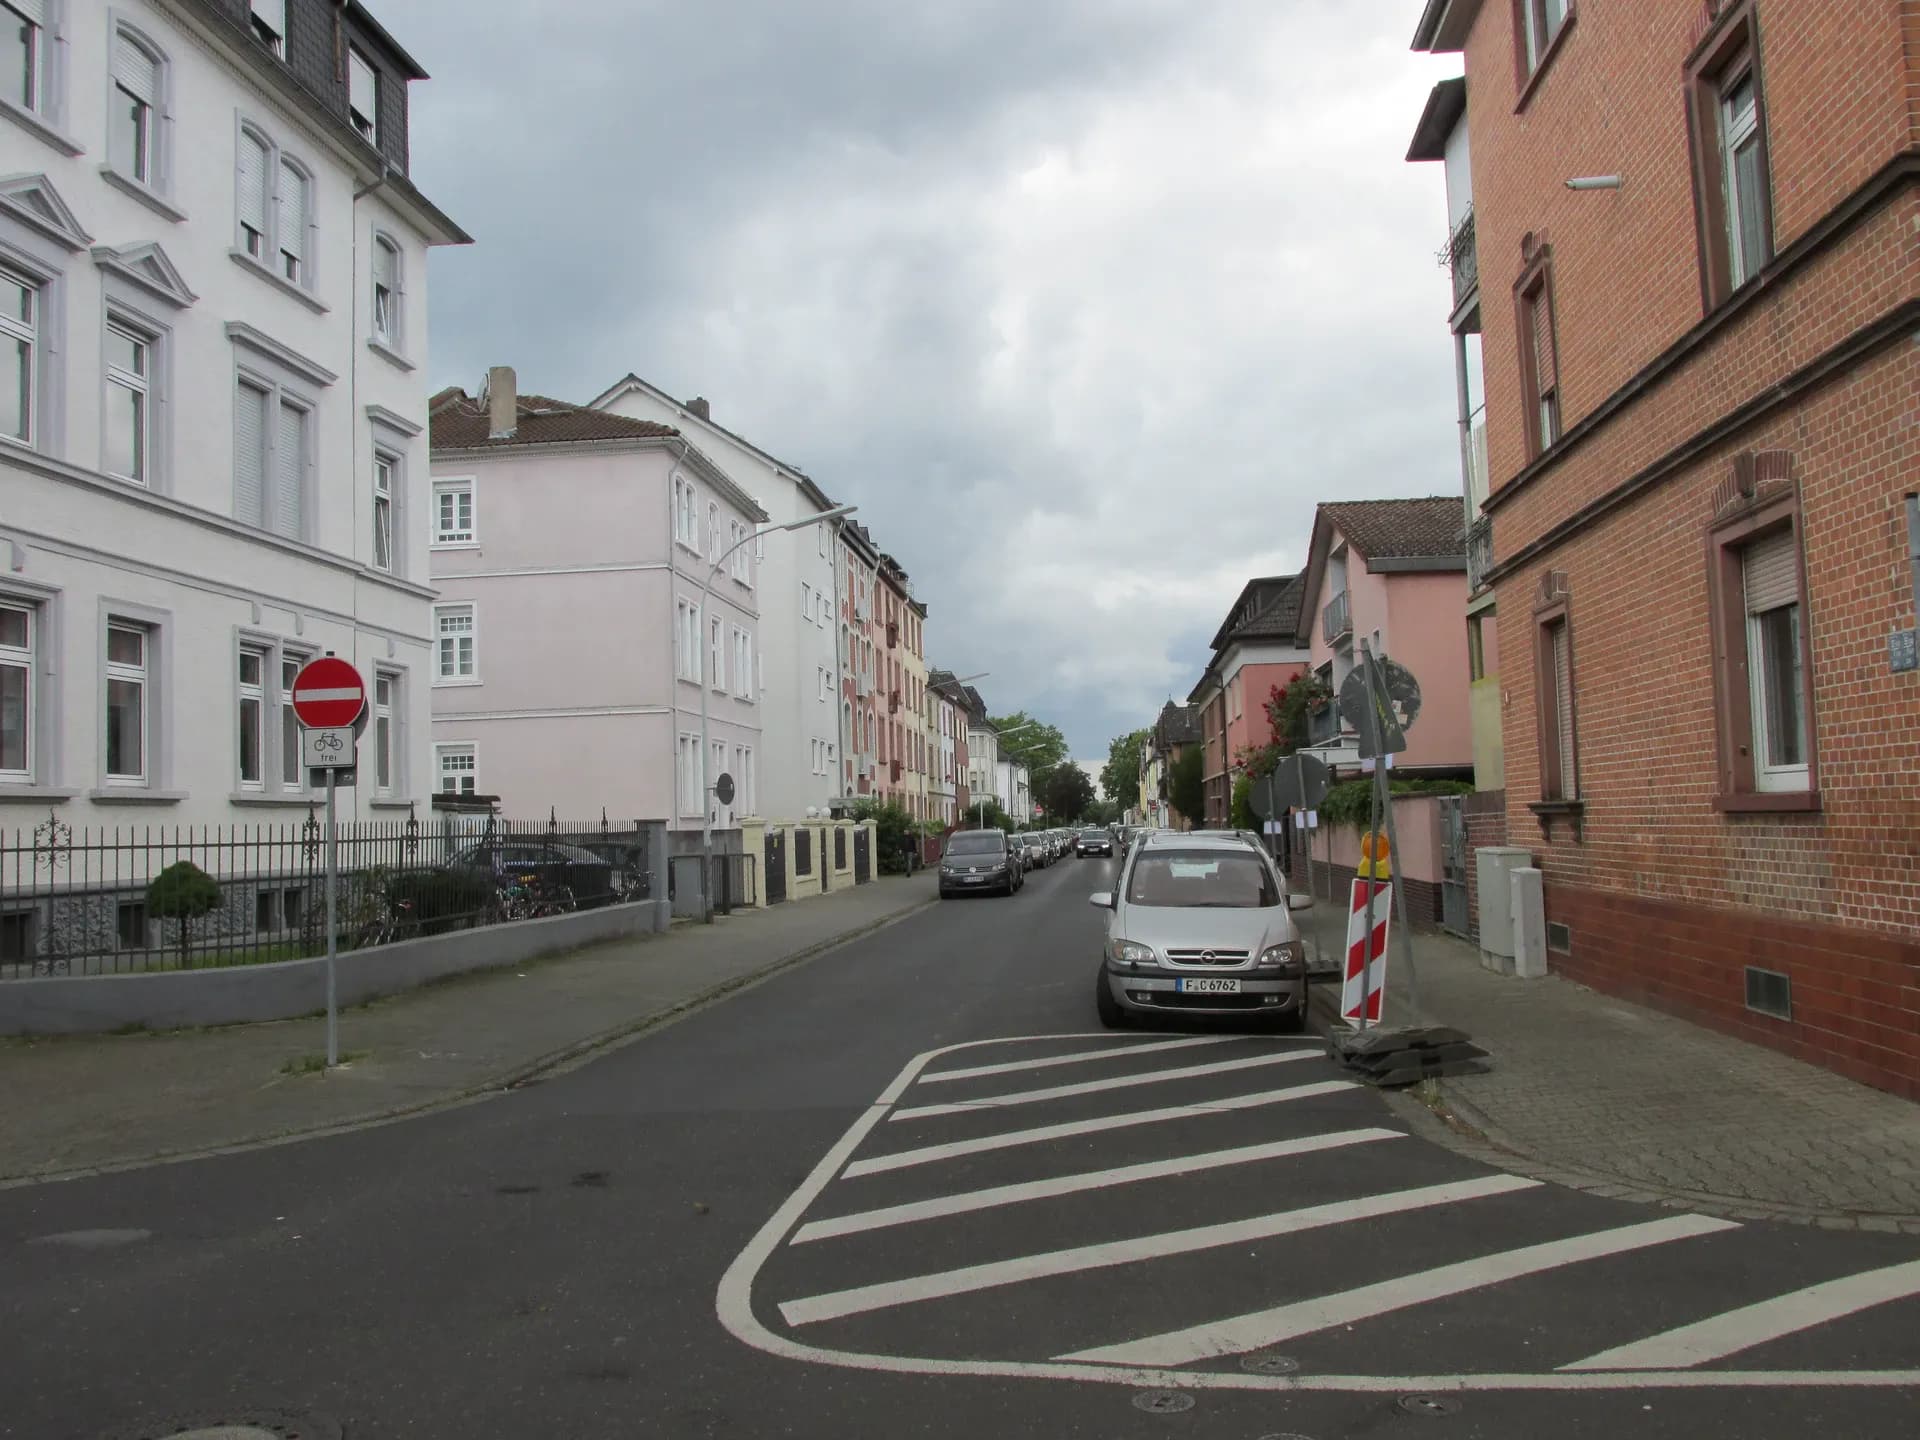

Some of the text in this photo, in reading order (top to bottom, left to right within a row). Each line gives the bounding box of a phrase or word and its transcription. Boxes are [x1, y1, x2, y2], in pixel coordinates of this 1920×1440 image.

[320, 753, 337, 762] frei
[1186, 980, 1193, 991] F
[1209, 980, 1236, 991] 6762
